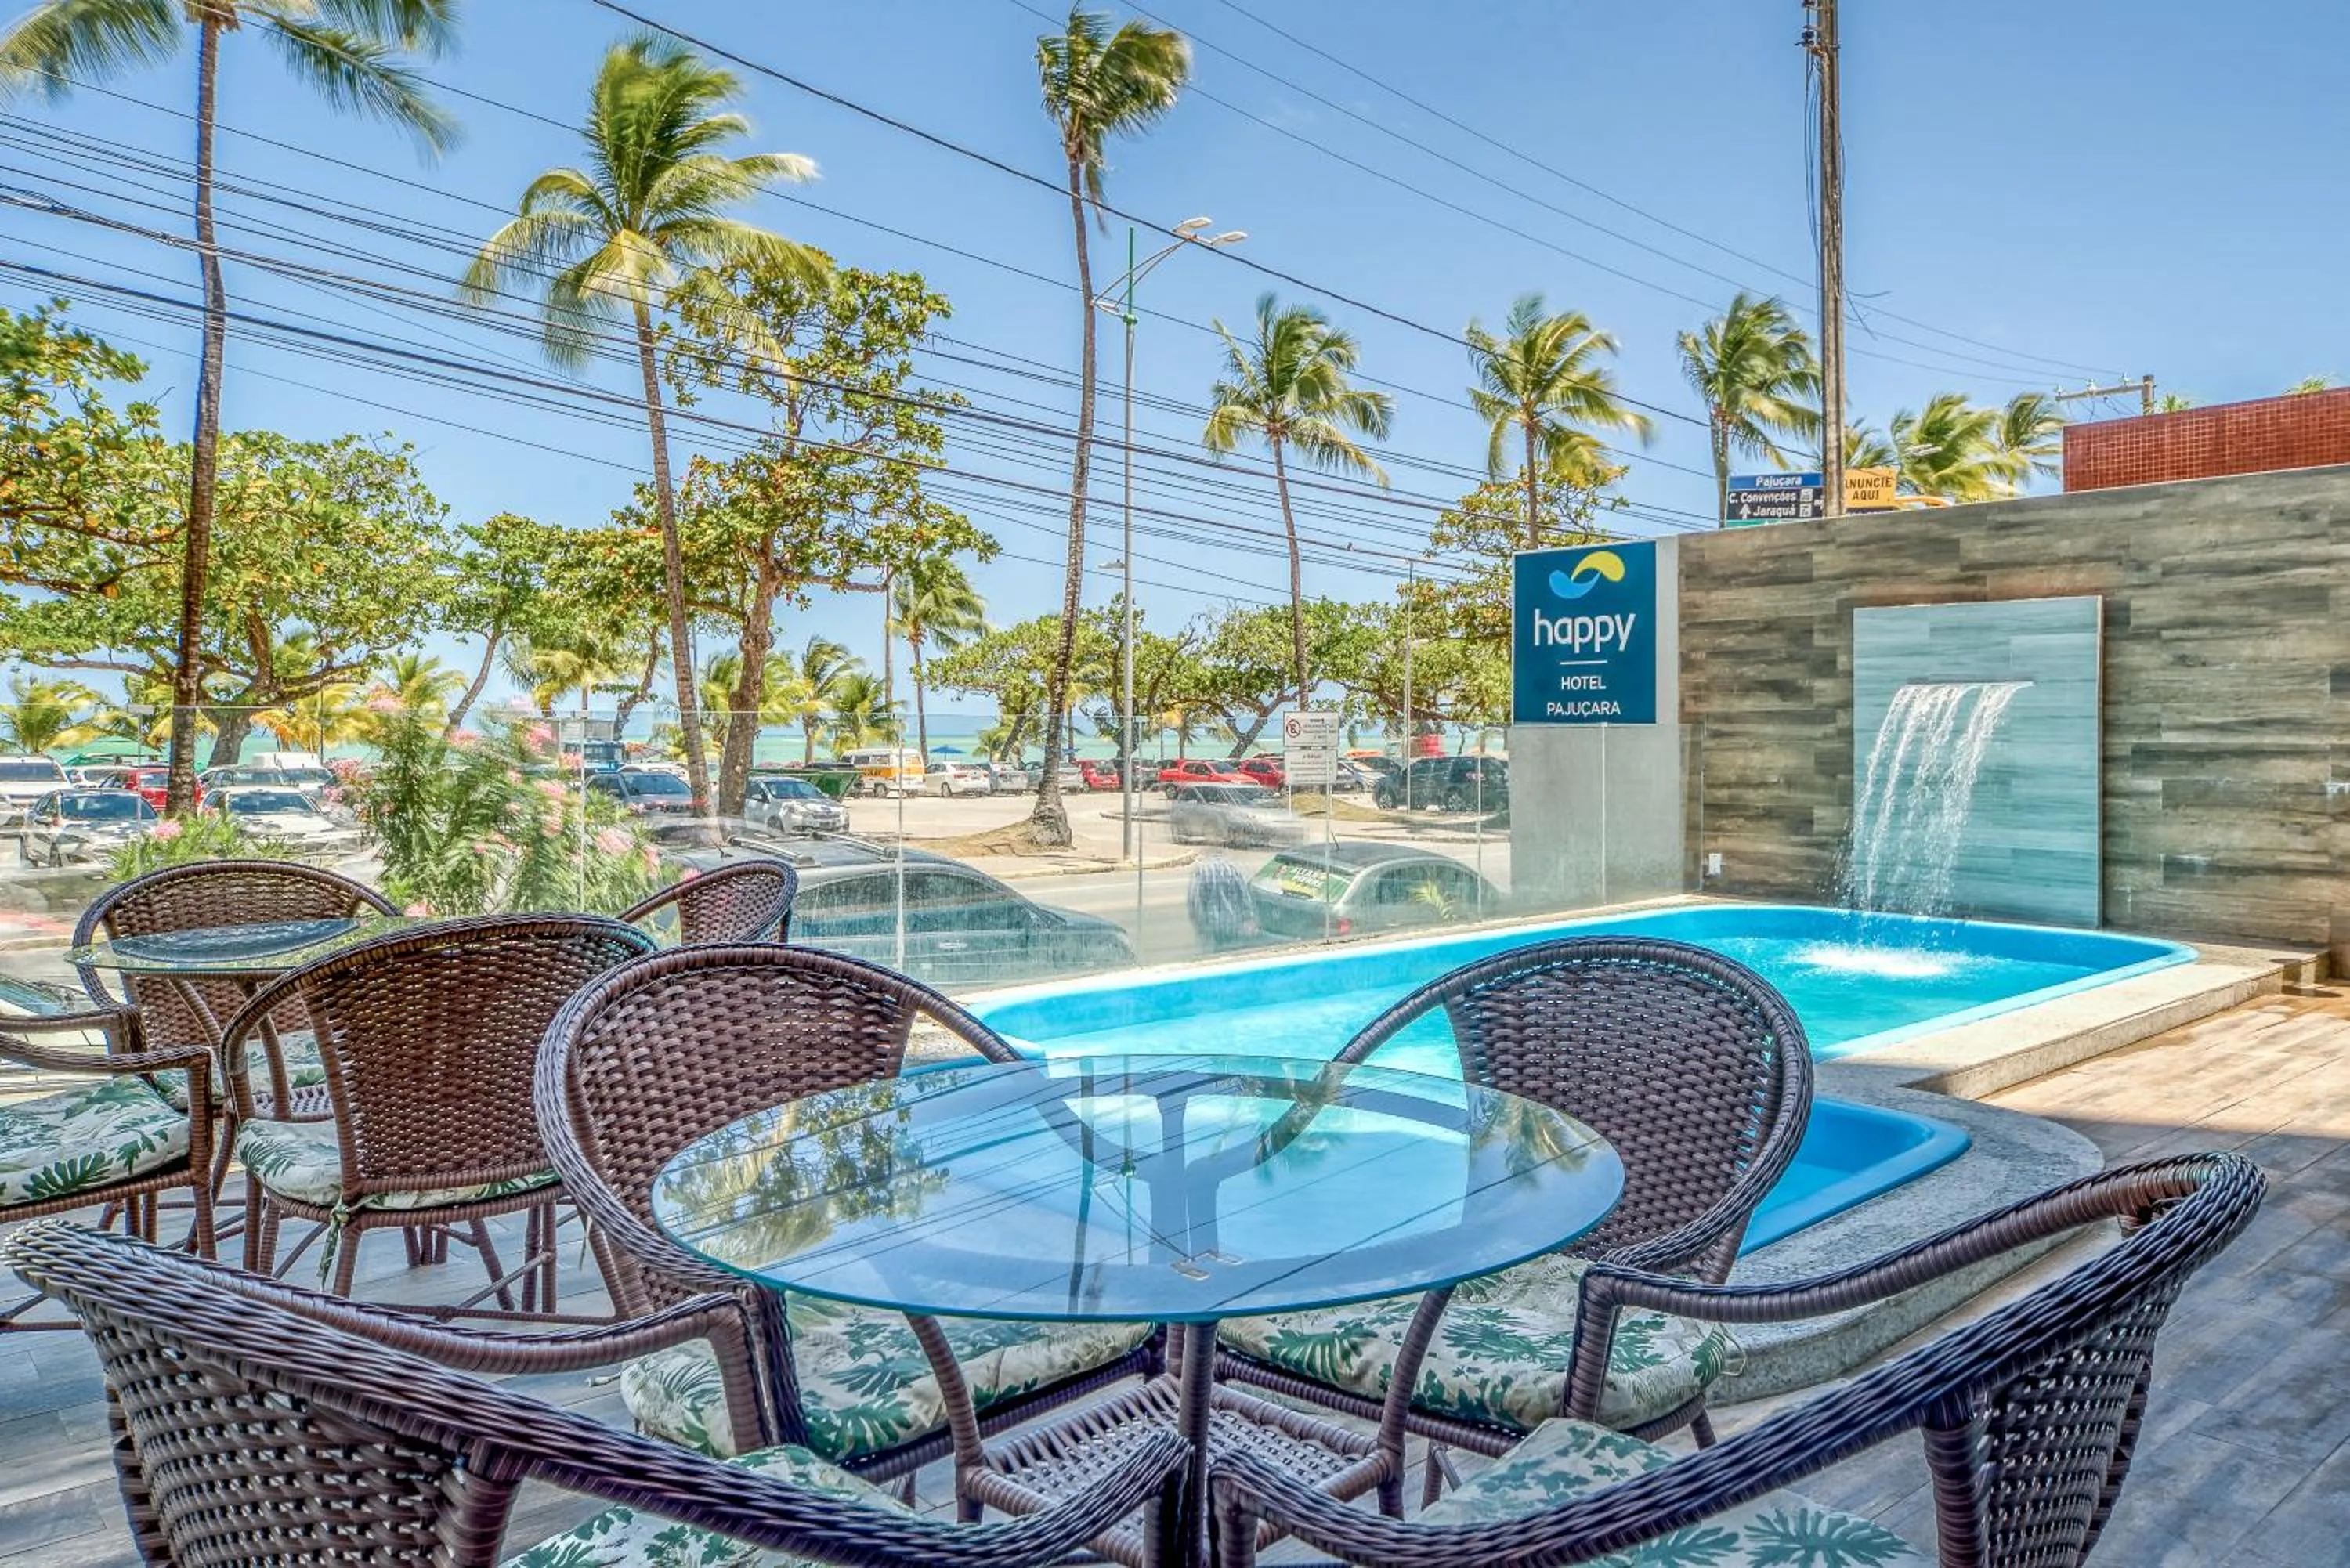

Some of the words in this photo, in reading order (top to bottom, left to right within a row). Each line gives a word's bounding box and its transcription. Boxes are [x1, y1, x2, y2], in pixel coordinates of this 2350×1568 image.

[1755, 475, 1802, 489] Pajuçara
[1729, 493, 1738, 504] C.
[1852, 490, 1879, 500] AQUI
[1535, 608, 1636, 654] happy
[1561, 676, 1607, 690] HOTEL
[1546, 701, 1622, 717] PAJUÇARA
